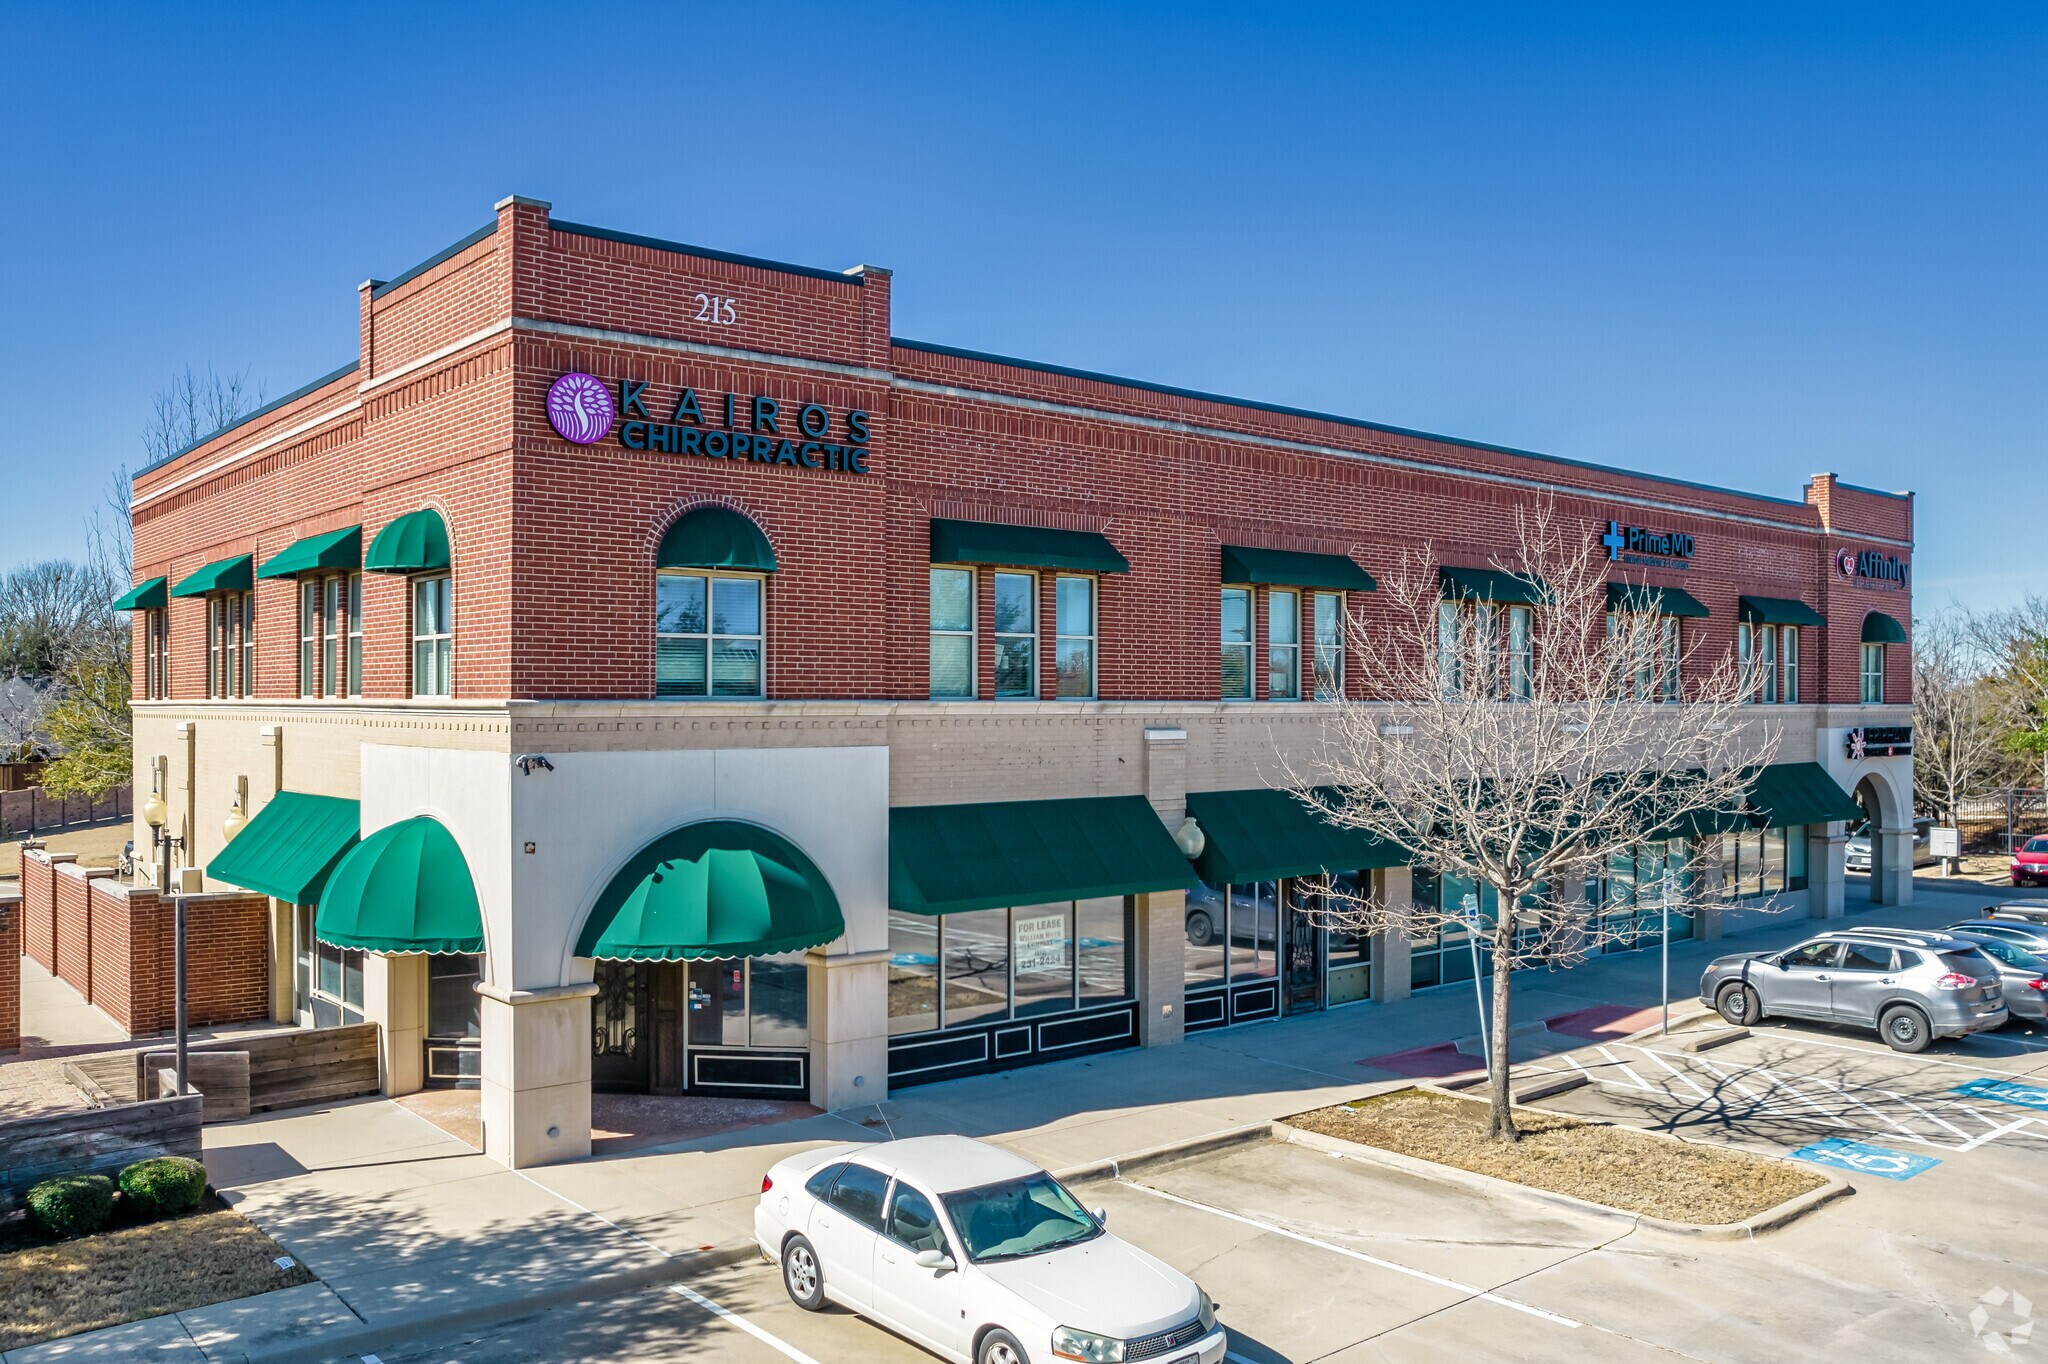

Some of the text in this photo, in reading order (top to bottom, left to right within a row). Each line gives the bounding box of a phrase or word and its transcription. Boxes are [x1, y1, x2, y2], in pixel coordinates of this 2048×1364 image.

[694, 293, 737, 326] 215
[619, 379, 871, 444] KAIROS
[619, 421, 871, 474] CHIROPRACTIC
[1626, 527, 1670, 555] Prime
[1858, 551, 1909, 590] Affinity
[1018, 919, 1061, 933] FOR LEASE
